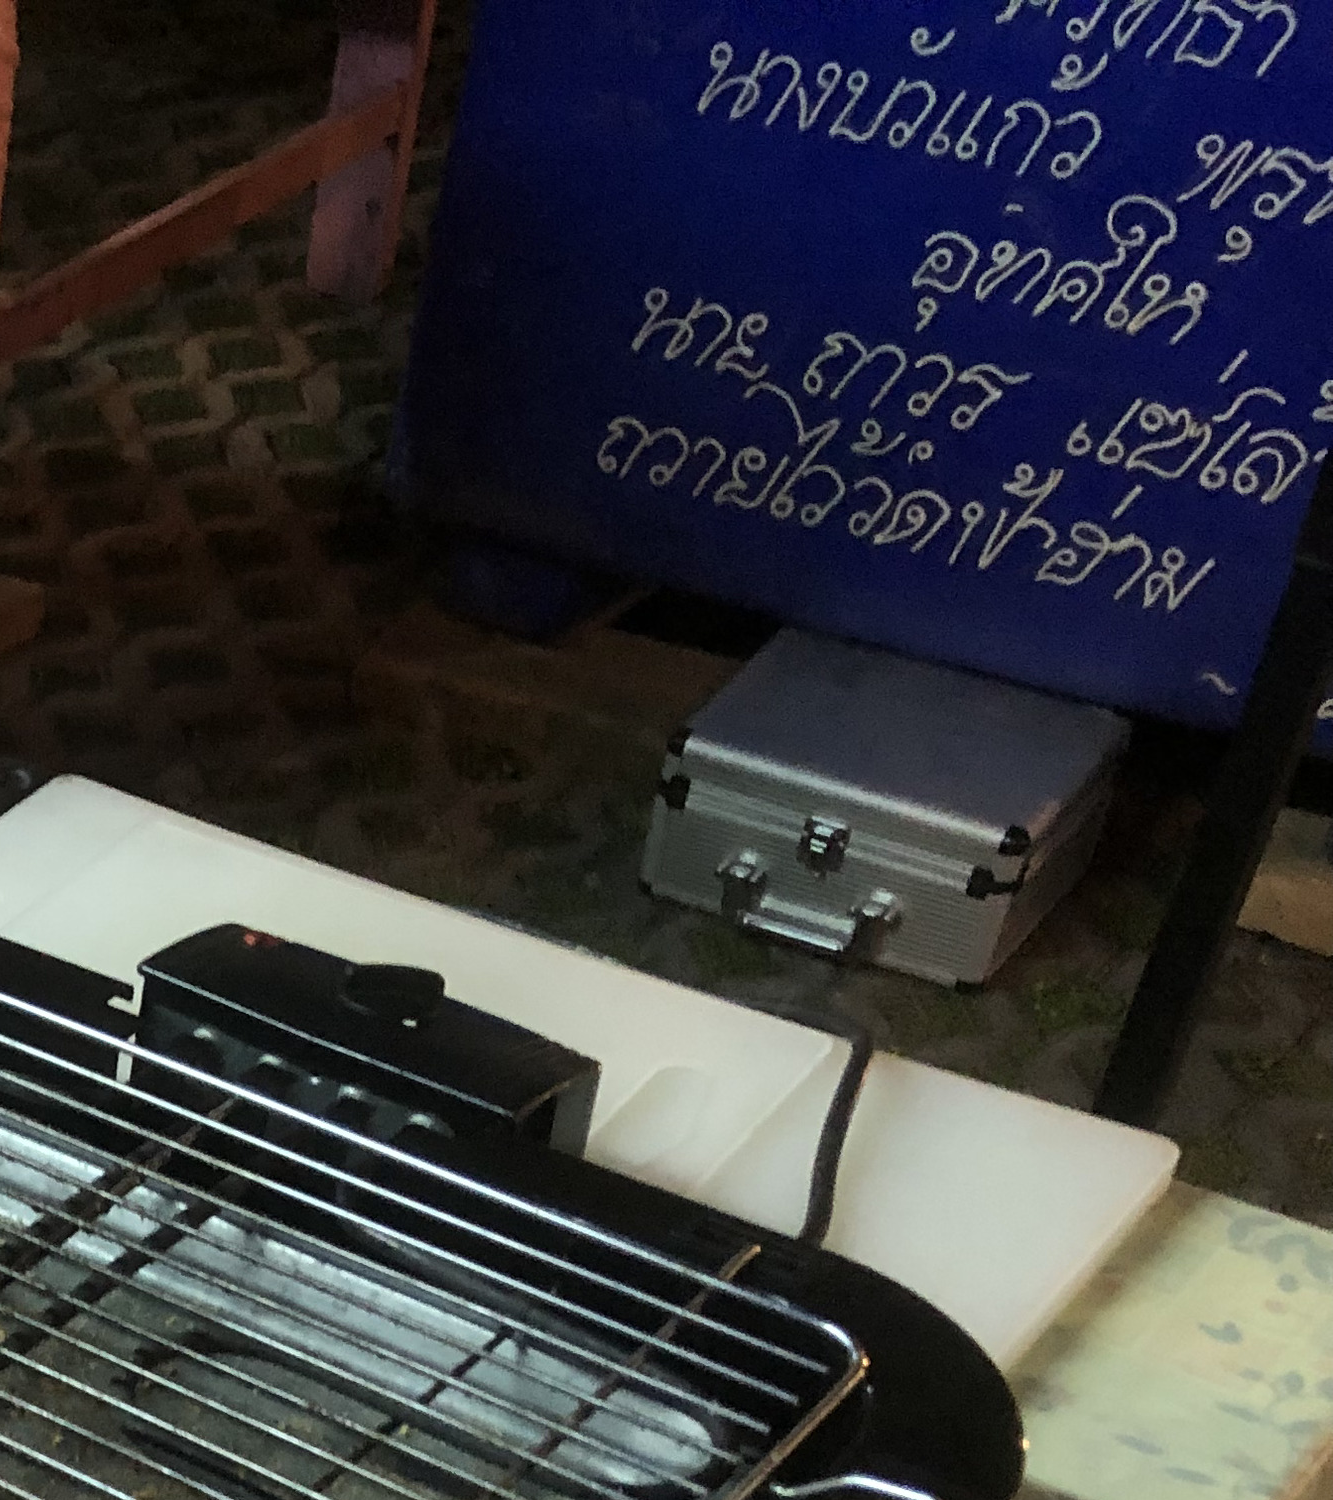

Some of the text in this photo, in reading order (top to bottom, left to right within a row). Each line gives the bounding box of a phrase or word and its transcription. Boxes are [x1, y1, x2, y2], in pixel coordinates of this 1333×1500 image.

[696, 26, 1102, 179] นางบัวแก้ว
[631, 287, 770, 380] นาย
[802, 331, 1033, 430] ถาวร
